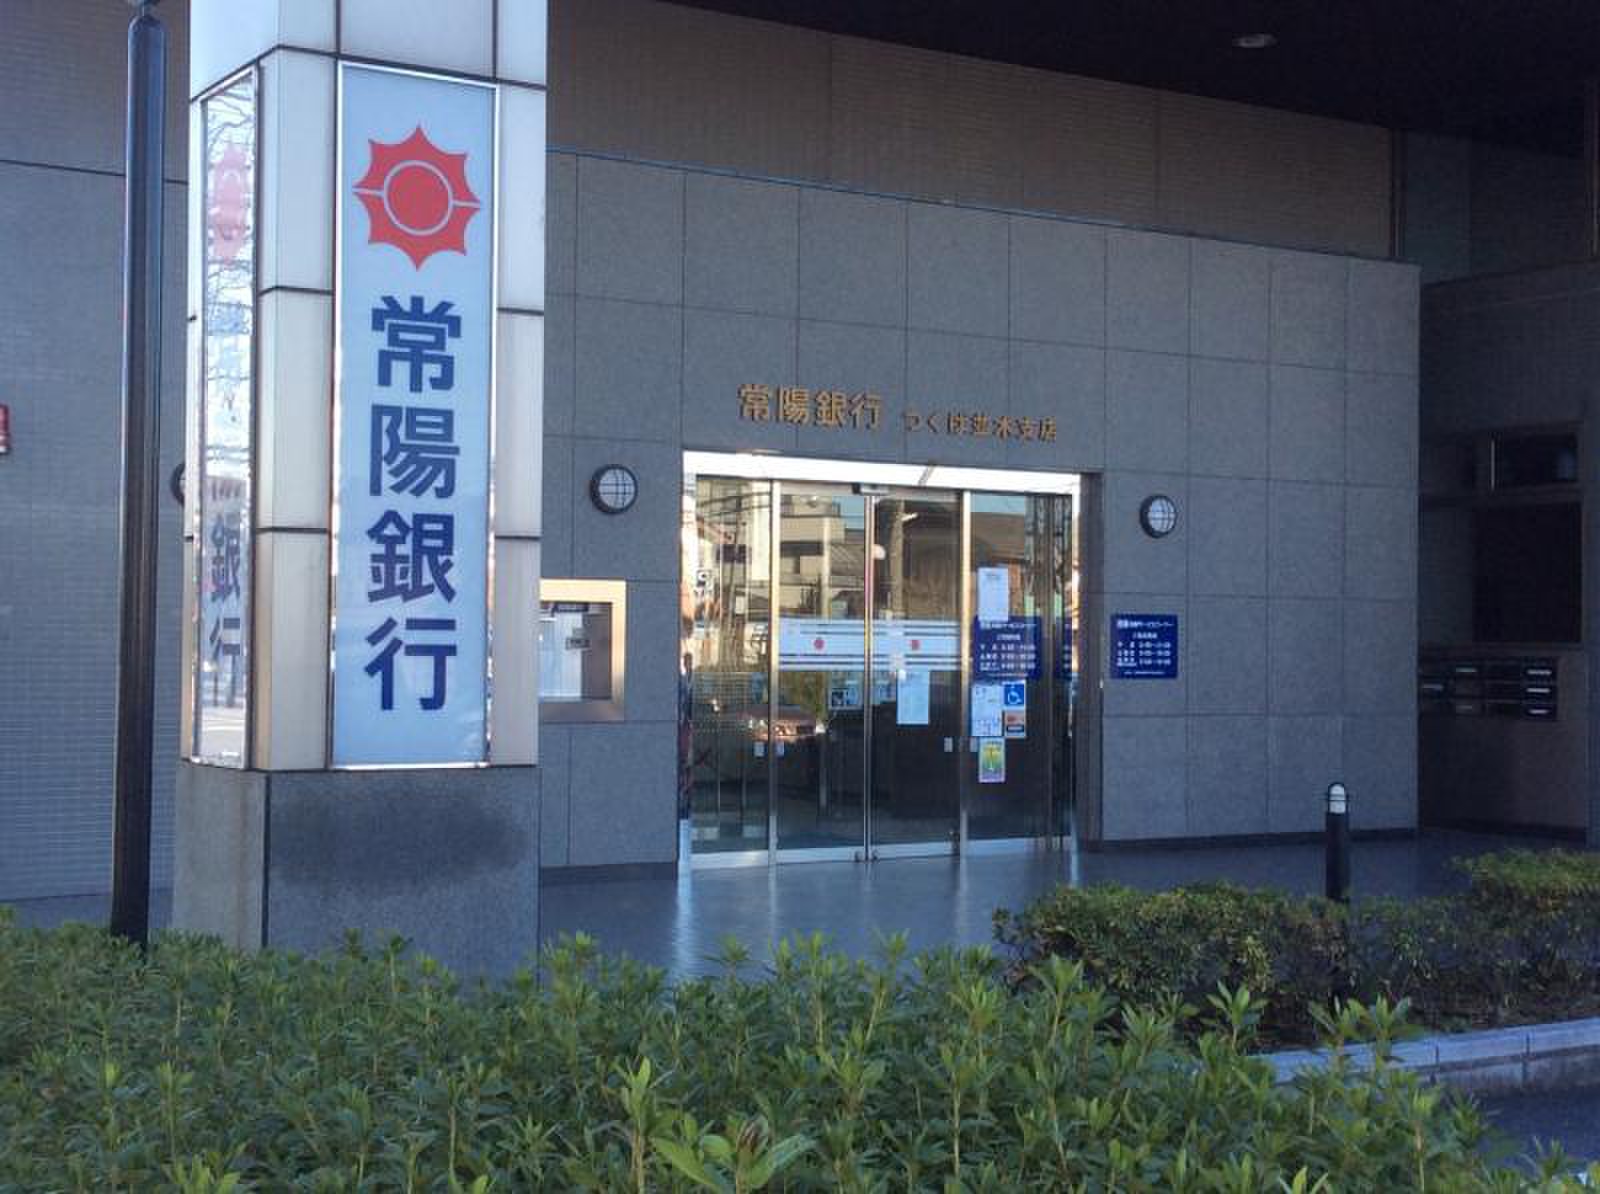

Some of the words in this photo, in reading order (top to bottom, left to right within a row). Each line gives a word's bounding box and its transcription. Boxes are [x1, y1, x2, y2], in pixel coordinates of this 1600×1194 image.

[364, 295, 462, 712] 常陽銀行
[738, 384, 882, 428] 常陽銀行
